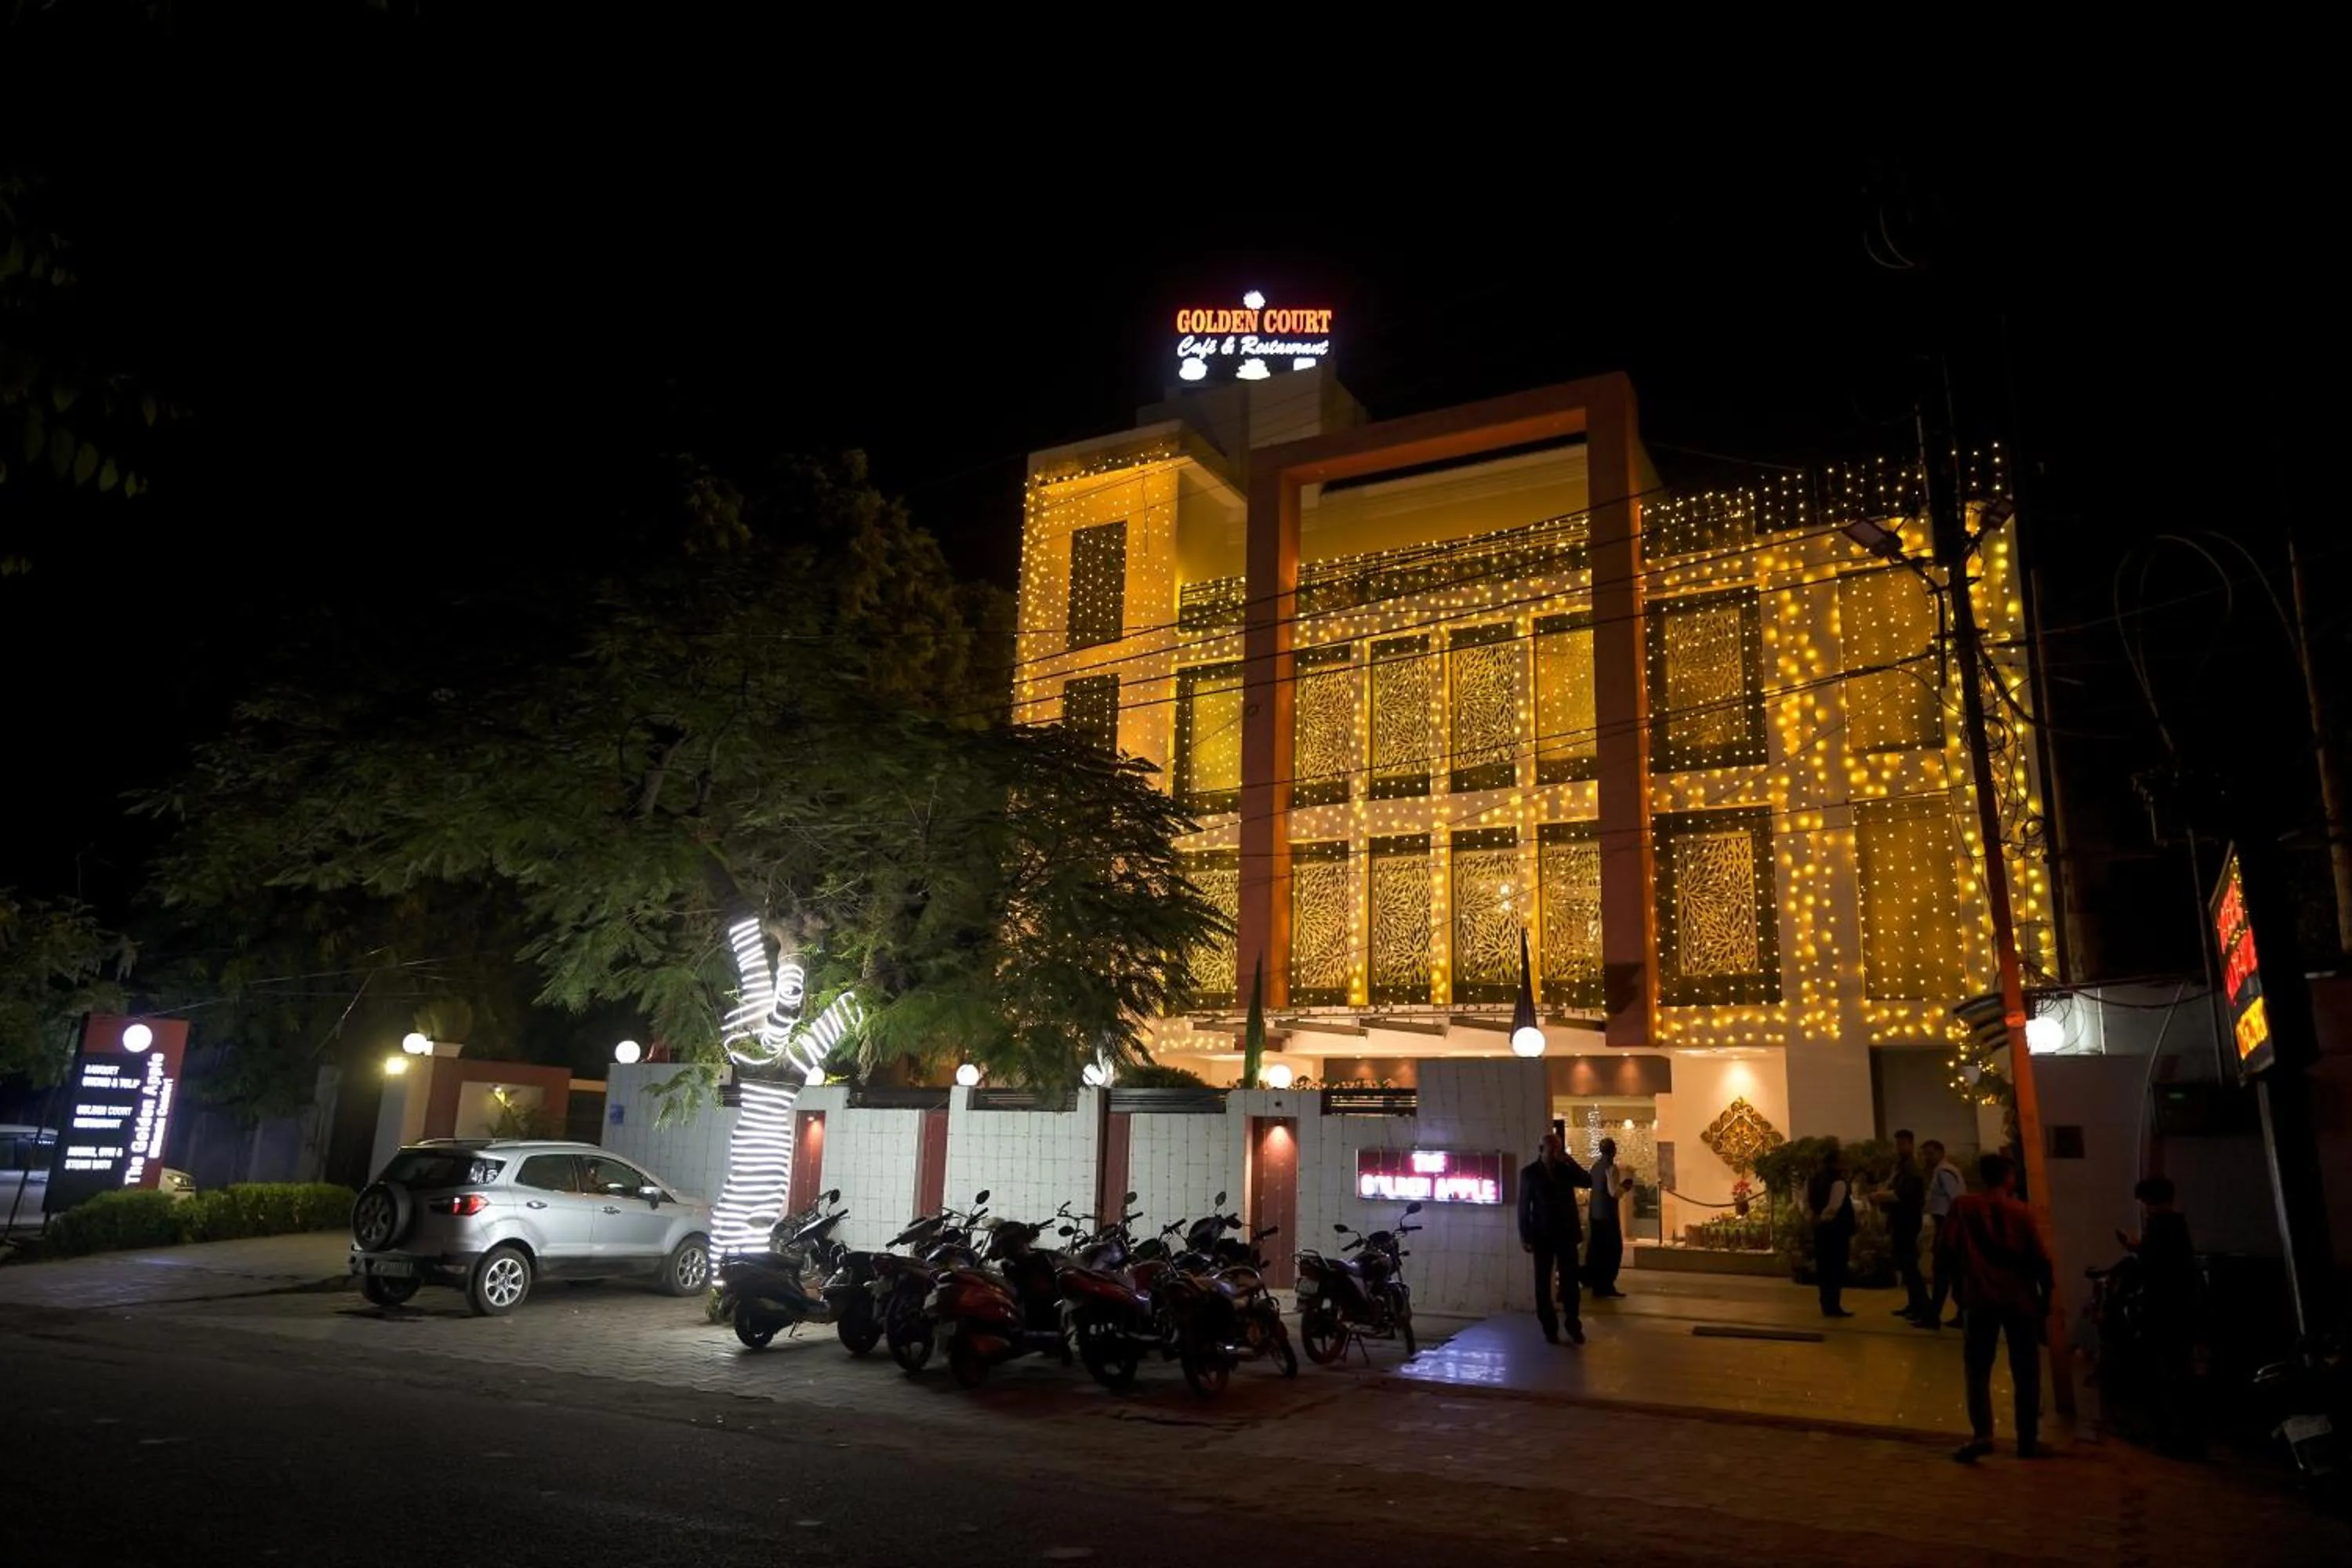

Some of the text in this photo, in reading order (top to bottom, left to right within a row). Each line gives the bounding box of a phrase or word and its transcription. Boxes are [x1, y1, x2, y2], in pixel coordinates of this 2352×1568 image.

[1177, 309, 1331, 333] GOLDEN COURT
[1221, 335, 1235, 355] &
[1240, 335, 1329, 355] Restaurant
[142, 1053, 164, 1097] Apple
[131, 1098, 156, 1153] Golden
[124, 1156, 144, 1185] The
[1435, 1177, 1497, 1200] APPLE
